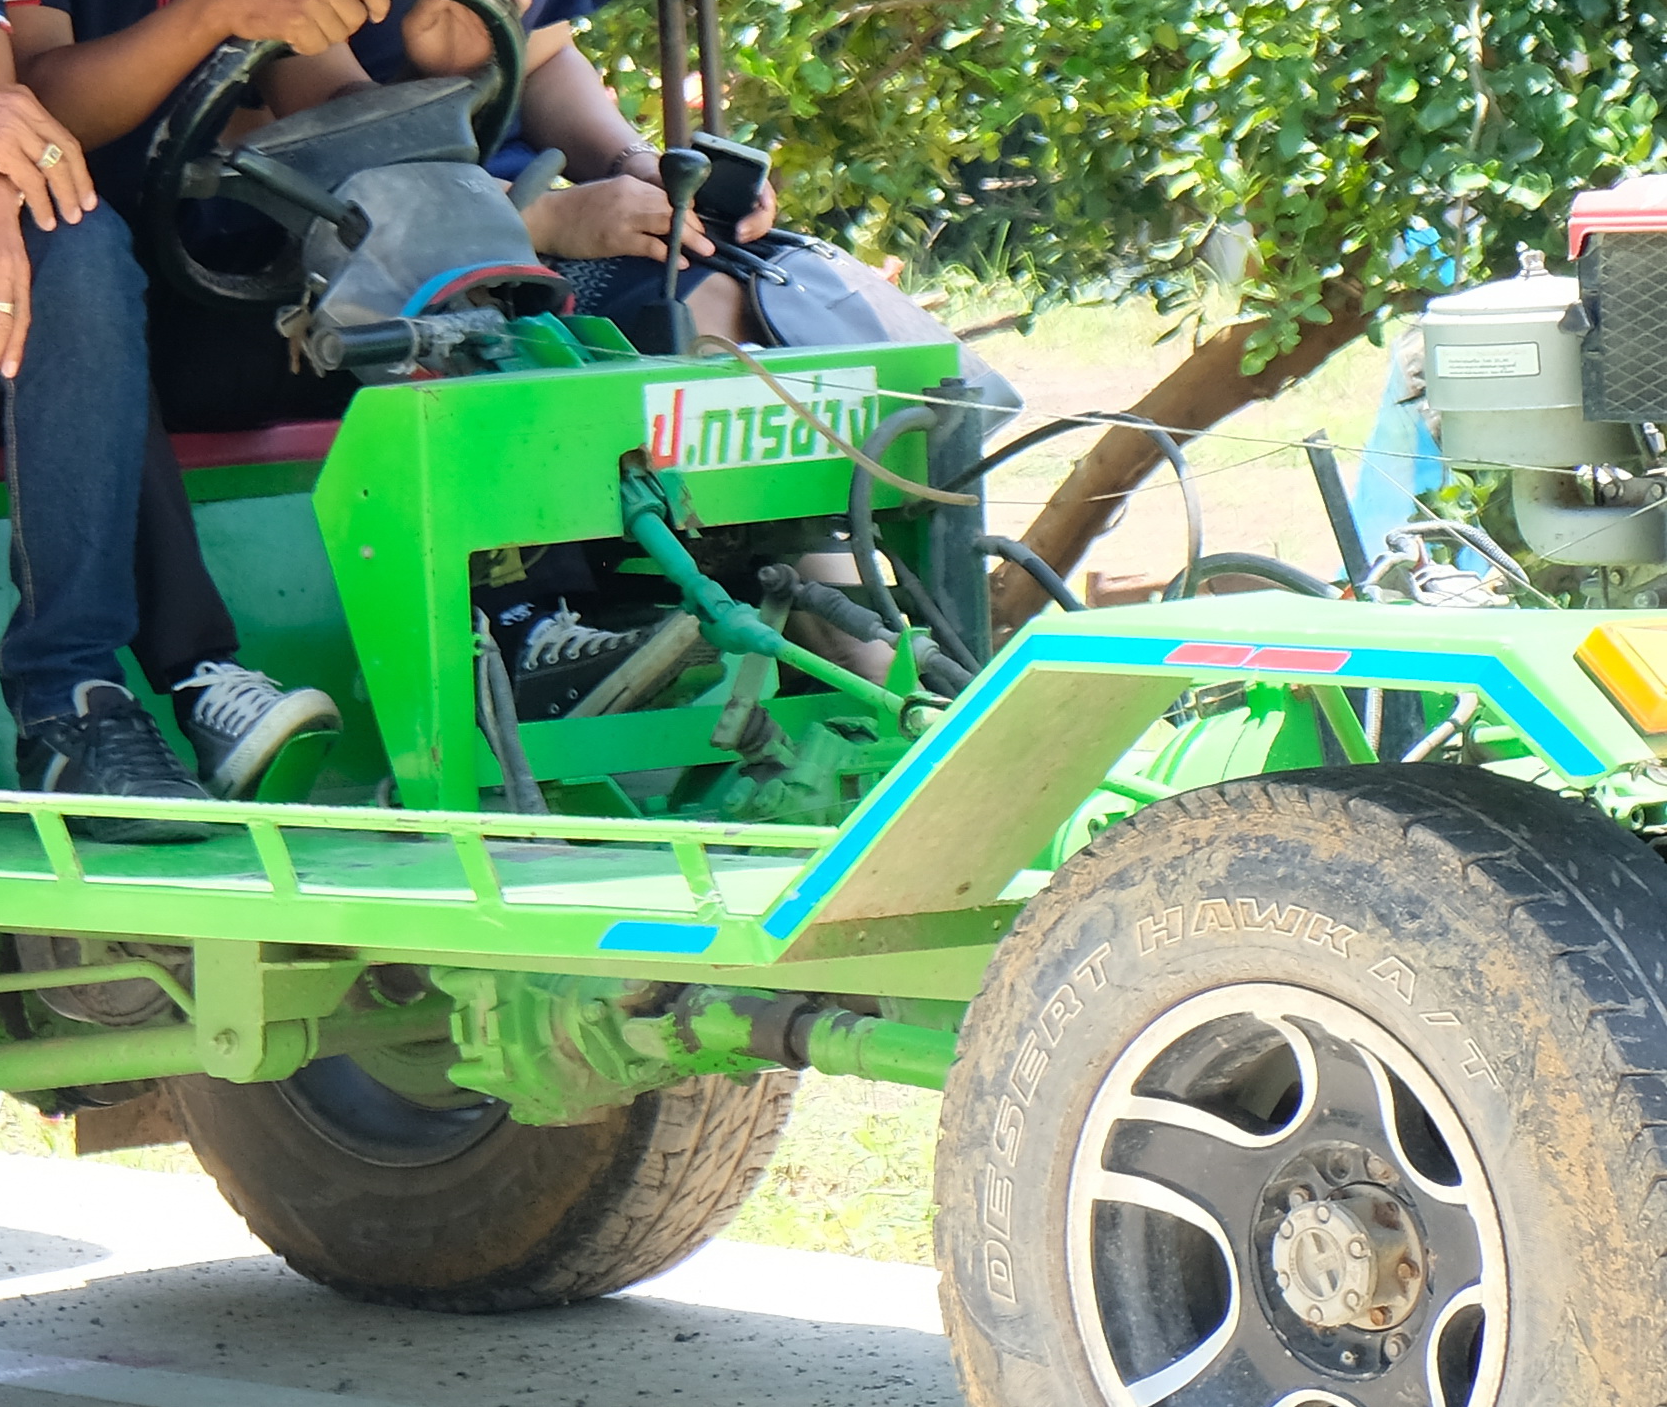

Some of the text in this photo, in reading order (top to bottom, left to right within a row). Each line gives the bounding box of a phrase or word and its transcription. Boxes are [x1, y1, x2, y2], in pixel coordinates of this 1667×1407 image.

[983, 896, 1503, 1305] DESERT HAWK A/T
